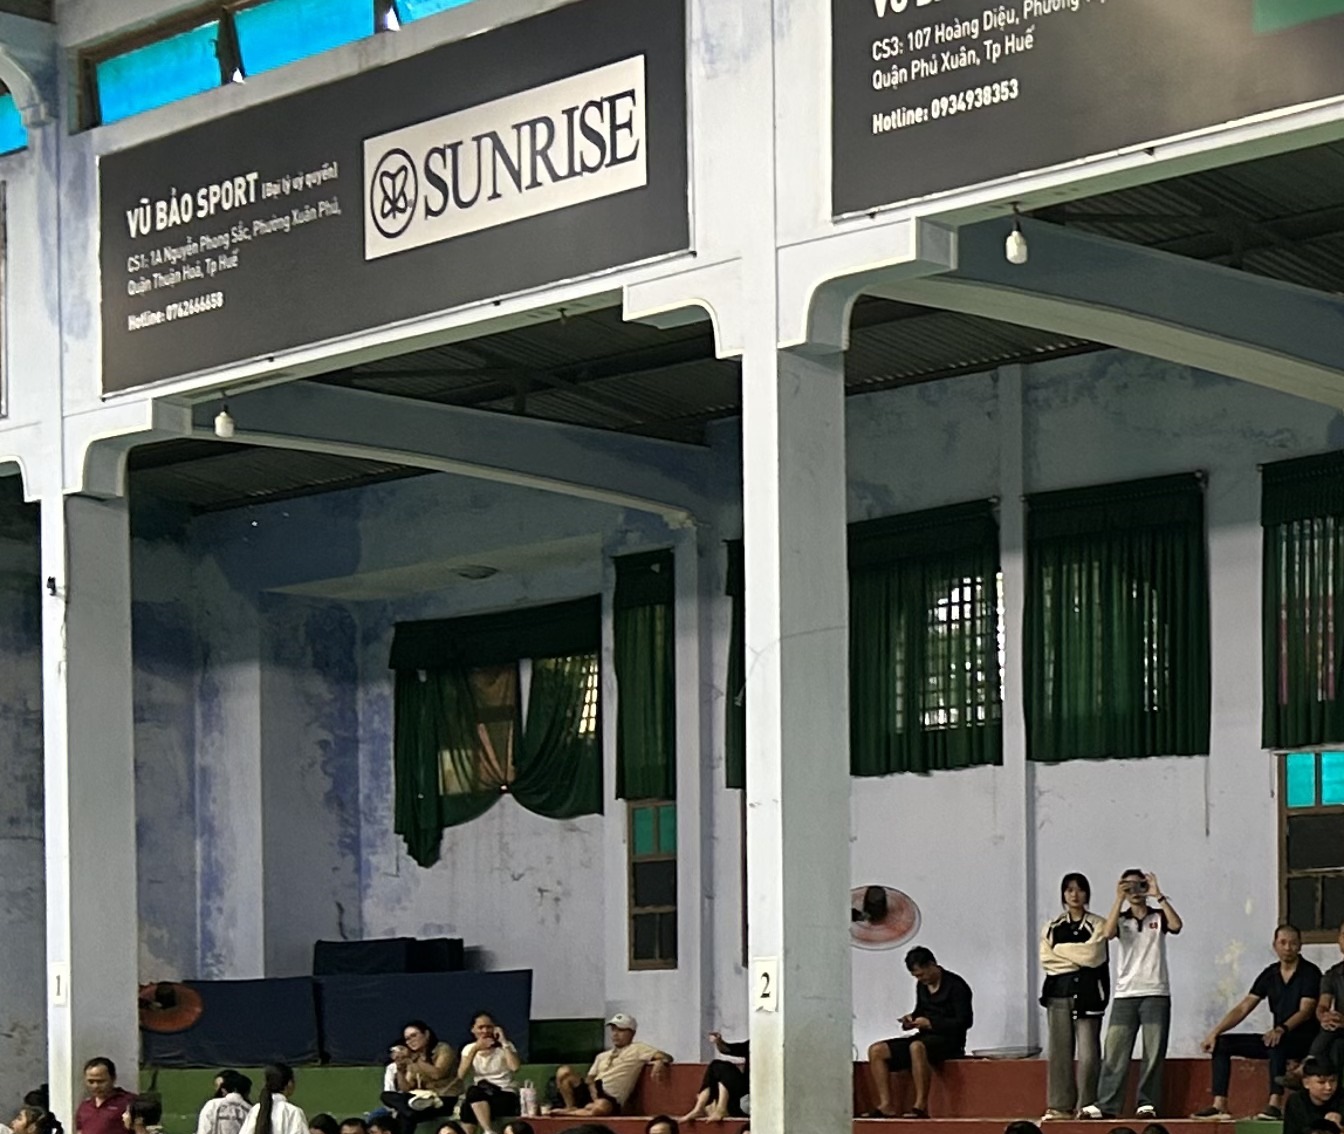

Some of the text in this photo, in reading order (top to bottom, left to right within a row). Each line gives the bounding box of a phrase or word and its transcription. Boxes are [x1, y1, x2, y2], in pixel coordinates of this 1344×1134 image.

[872, 36, 904, 61] CS3:
[907, 27, 931, 52] 107
[935, 18, 979, 44] Hoàng
[983, 6, 1019, 31] Diệu,
[872, 64, 908, 90] Quận
[941, 46, 980, 72] Xuân,
[984, 39, 1001, 64] Tp
[1005, 24, 1036, 55] Huế
[872, 79, 1019, 134] Hotline: 0934938353
[423, 89, 640, 221] SUNRISE
[126, 198, 151, 238] VŨ
[155, 187, 192, 231] BẢO
[196, 172, 259, 218] SPORT
[200, 233, 230, 252] Phong
[253, 214, 290, 236] Phường
[291, 205, 317, 226] Xuân
[127, 276, 151, 297] Quận
[152, 268, 181, 288] Thuận
[205, 258, 217, 277] Tp
[218, 247, 240, 271] Huế
[127, 311, 165, 331] Hotline:
[56, 975, 61, 997] 1
[760, 972, 771, 998] 2
